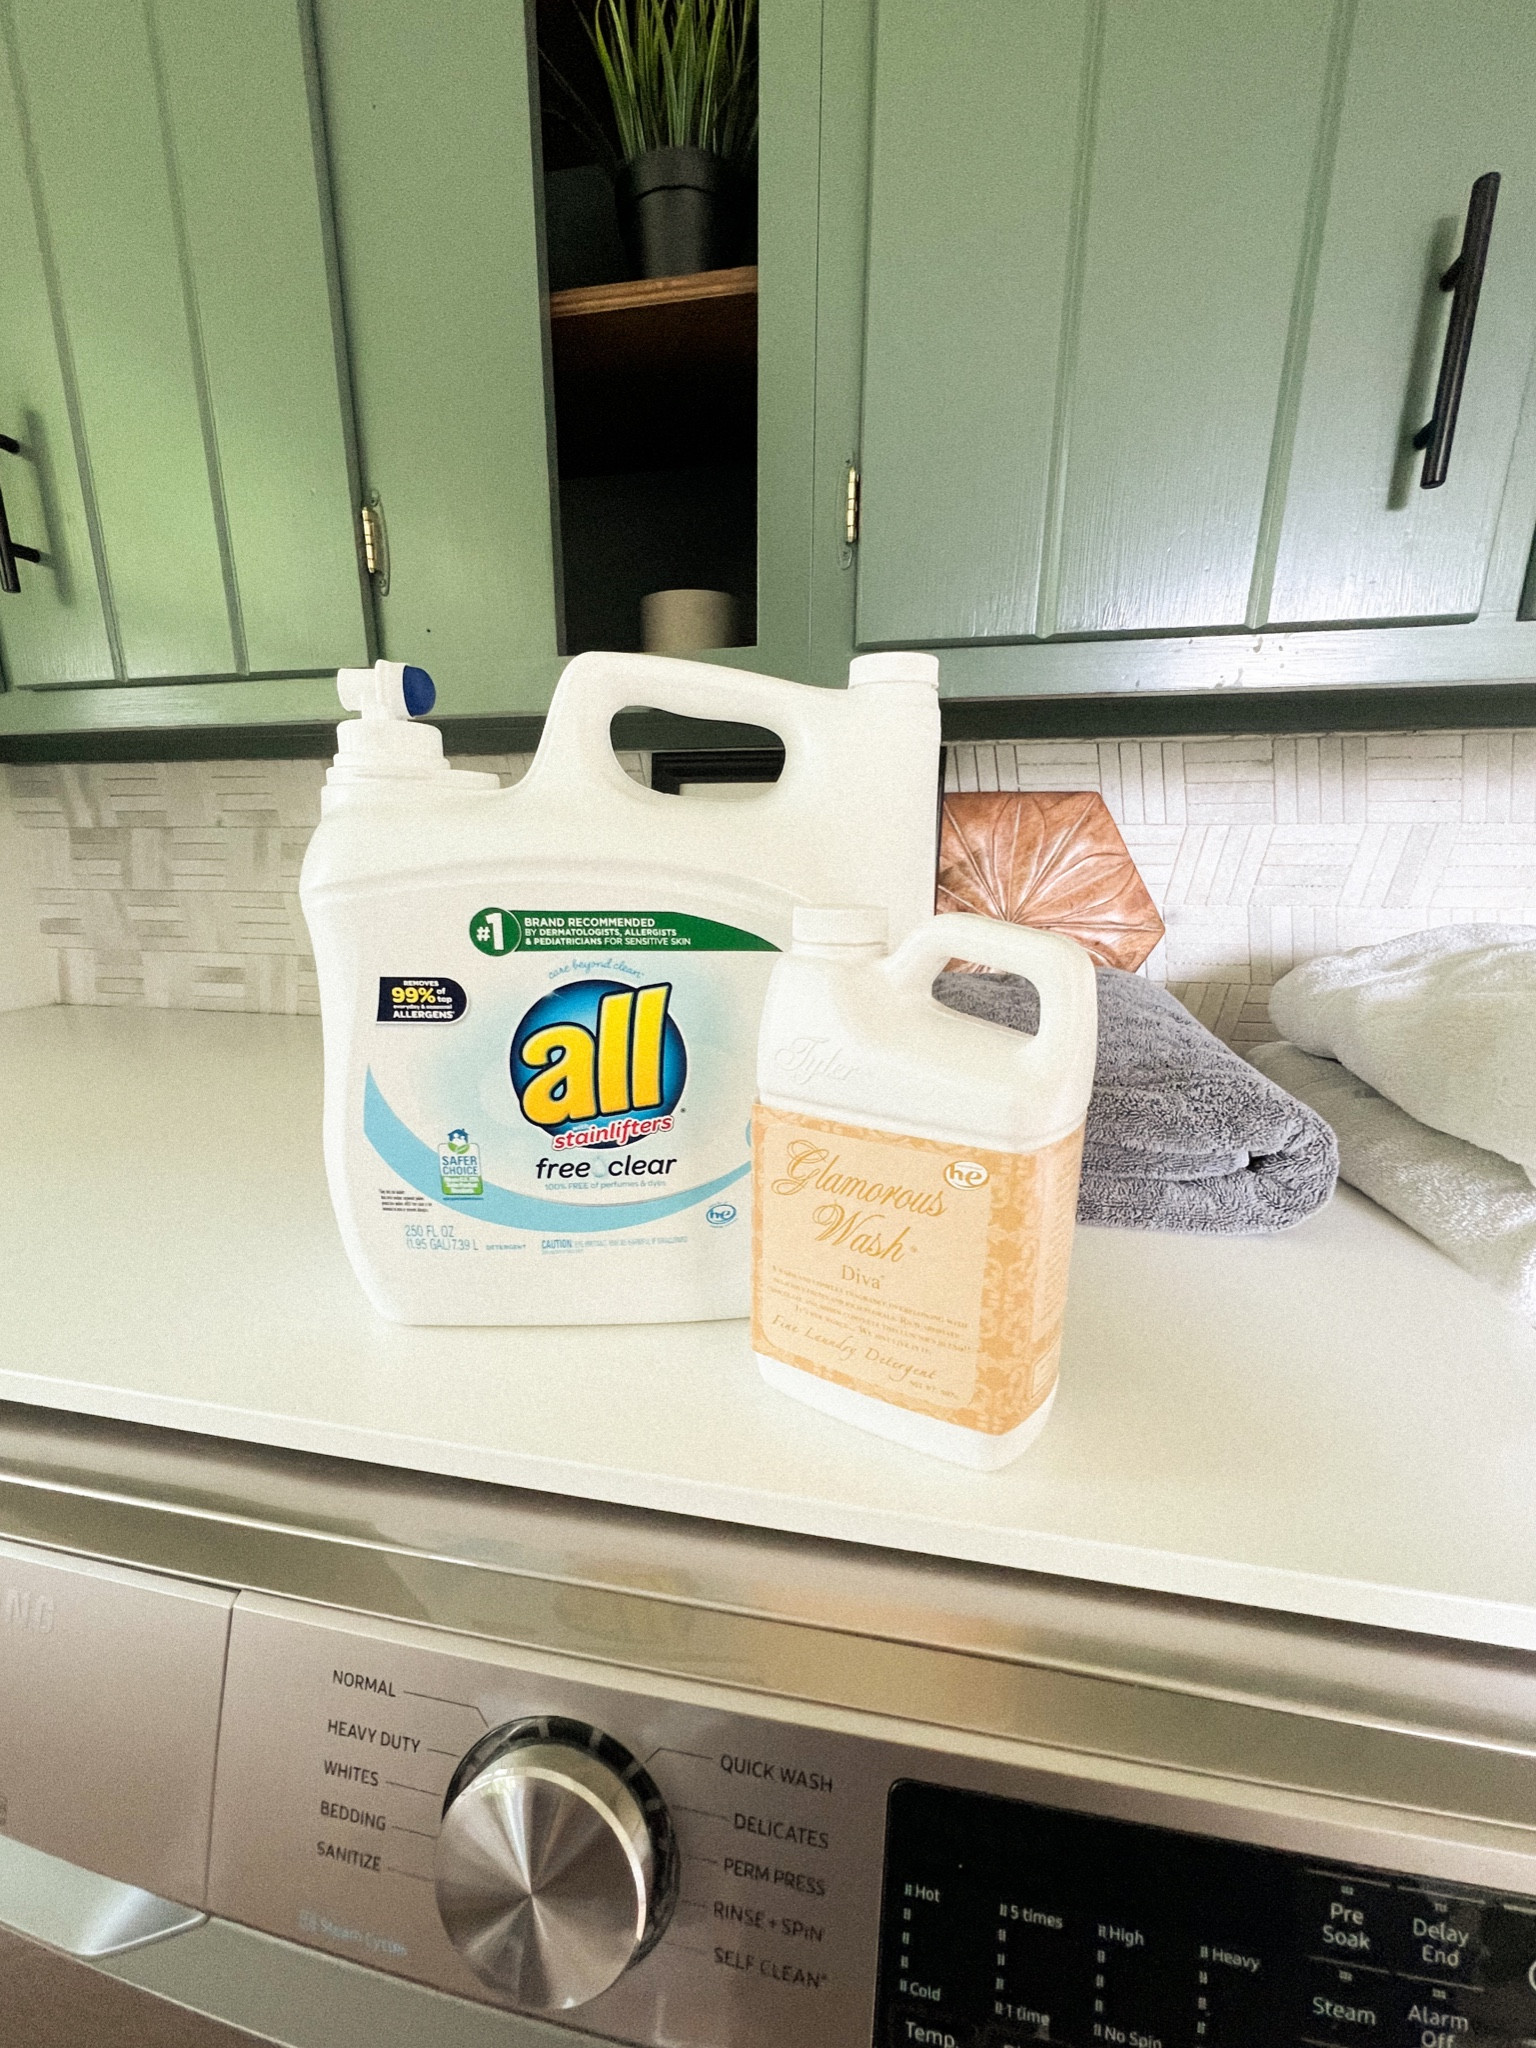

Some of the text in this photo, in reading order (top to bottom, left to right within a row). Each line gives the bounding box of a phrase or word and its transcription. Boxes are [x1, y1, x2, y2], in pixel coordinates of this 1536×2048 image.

[476, 912, 504, 951] #1
[524, 917, 656, 928] BRAND RECOMMENDED
[524, 928, 677, 938] BY DERMATOLOGISTS, ALLERGISTS
[534, 937, 602, 945] PEDIATRICIANS
[604, 937, 623, 945] FOR
[624, 937, 669, 946] SENSITIVE
[670, 937, 691, 945] SKIN
[548, 965, 570, 979] care
[572, 958, 612, 974] beyond
[391, 986, 446, 1003] 99% of
[437, 996, 453, 1004] top
[520, 982, 672, 1126] all
[553, 1116, 673, 1150] stainlifters
[441, 1155, 478, 1166] SAFER
[442, 1166, 478, 1175] CHOICE
[536, 1154, 678, 1179] free clear
[568, 1182, 589, 1190] FREE
[771, 1138, 948, 1218] Glamorous
[947, 1161, 986, 1188] he
[404, 1224, 455, 1238] 250 FL OZ
[812, 1200, 911, 1263] Wash
[473, 1239, 479, 1251] L
[841, 1264, 880, 1290] Diva
[864, 1347, 937, 1382] Detergent
[332, 1669, 397, 1698] NORMAL
[327, 1718, 421, 1754] HEAVY DUTY
[323, 1759, 380, 1787] WHITES
[720, 1754, 834, 1794] QUICK WASH
[319, 1799, 387, 1832] BEDDING
[733, 1812, 830, 1850] DELICATES
[315, 1840, 383, 1872] SANITIZE
[723, 1856, 826, 1897] PERM PRESS
[914, 1883, 940, 1903] Hot
[712, 1900, 766, 1928] RINSE
[780, 1917, 823, 1943] SPIN
[1010, 1904, 1063, 1930] 5 times
[1329, 1902, 1364, 1926] Pre
[1108, 1925, 1145, 1948] High
[1322, 1924, 1371, 1950] Soak
[1412, 1917, 1470, 1948] Delay
[713, 1946, 754, 1971] SELF
[1212, 1948, 1261, 1972] Heavy
[1421, 1944, 1460, 1968] End
[909, 1981, 942, 2002] Cold
[1006, 2003, 1051, 2027] 1 time
[1312, 1996, 1377, 2026] Steam
[1407, 2004, 1469, 2032] Alarm
[1104, 2025, 1162, 2048] No Spin
[1421, 2030, 1457, 2048] Off
